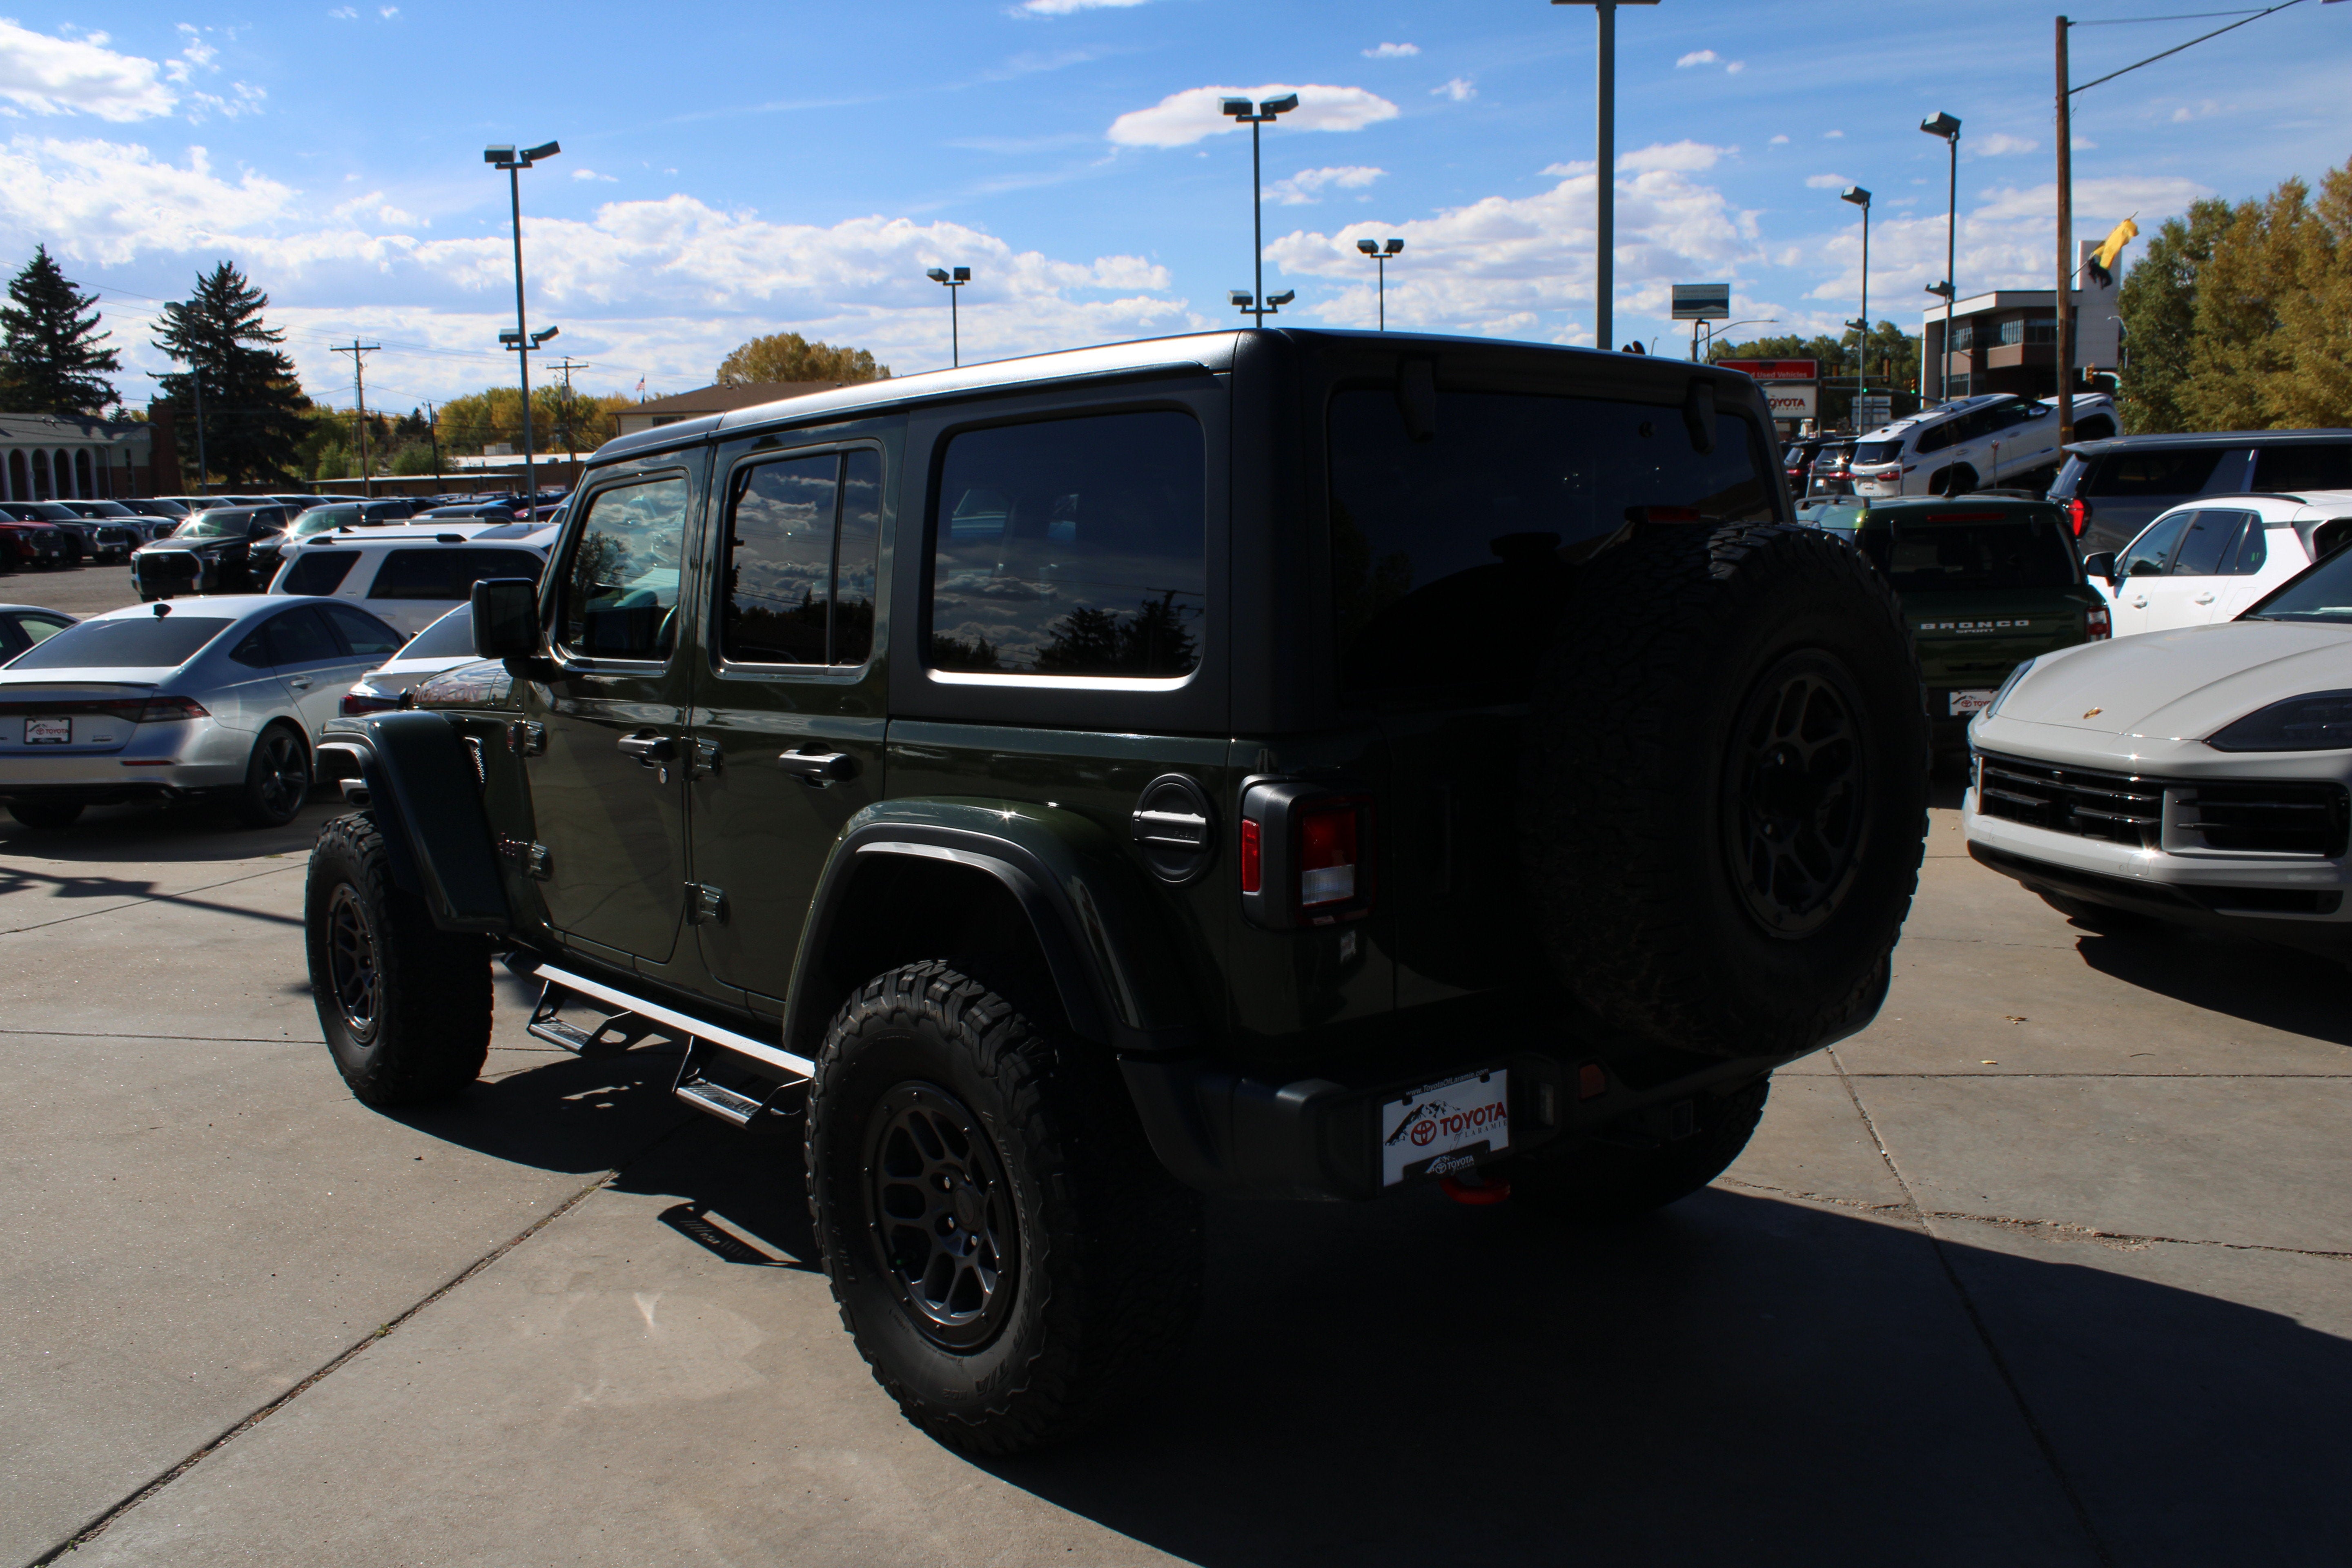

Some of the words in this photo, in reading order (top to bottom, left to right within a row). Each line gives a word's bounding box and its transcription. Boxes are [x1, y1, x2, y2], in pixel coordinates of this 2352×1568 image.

[1768, 398, 1805, 407] OYOTA
[1920, 620, 2030, 630] BRONCO
[413, 684, 481, 702] RUBICON
[1405, 1068, 1489, 1096] www.ToyotaOfLaramie.com
[1440, 1102, 1507, 1136] TOYOTA
[1465, 1120, 1508, 1138] LARAMIE
[1447, 1155, 1474, 1170] TOYOTA
